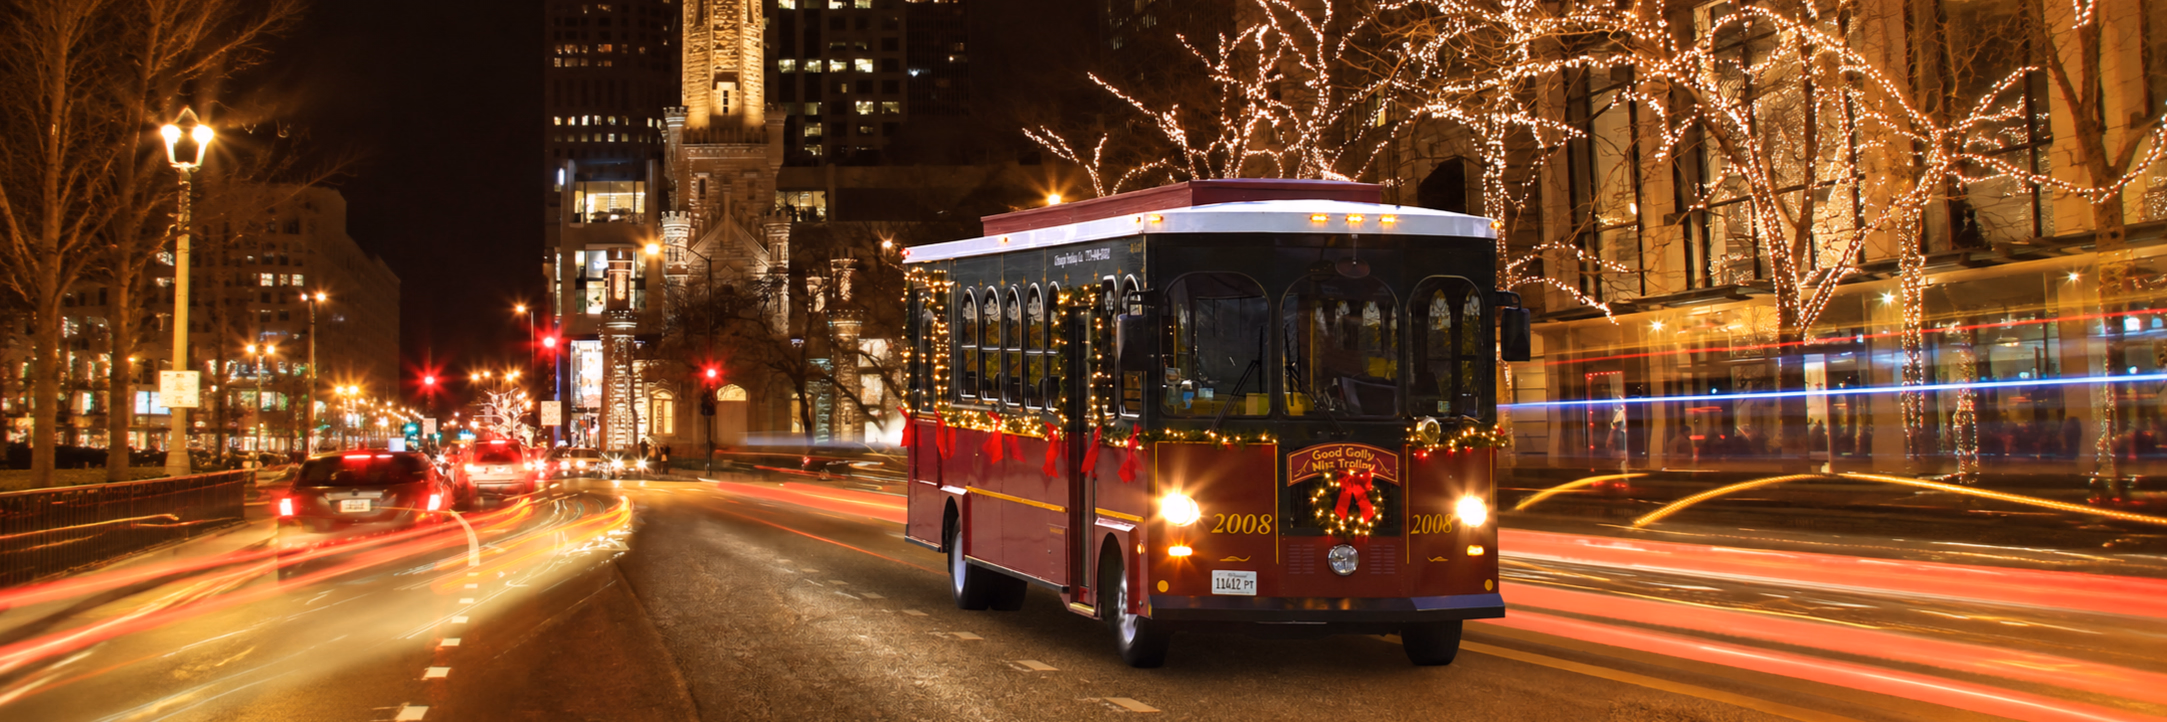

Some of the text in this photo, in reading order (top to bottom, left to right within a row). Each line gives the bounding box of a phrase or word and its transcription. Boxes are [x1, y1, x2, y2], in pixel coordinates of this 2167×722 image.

[1312, 447, 1375, 461] Good Golly
[1211, 513, 1273, 535] 2008
[1410, 513, 1453, 535] 2008
[1216, 577, 1254, 590] 11412 PT
